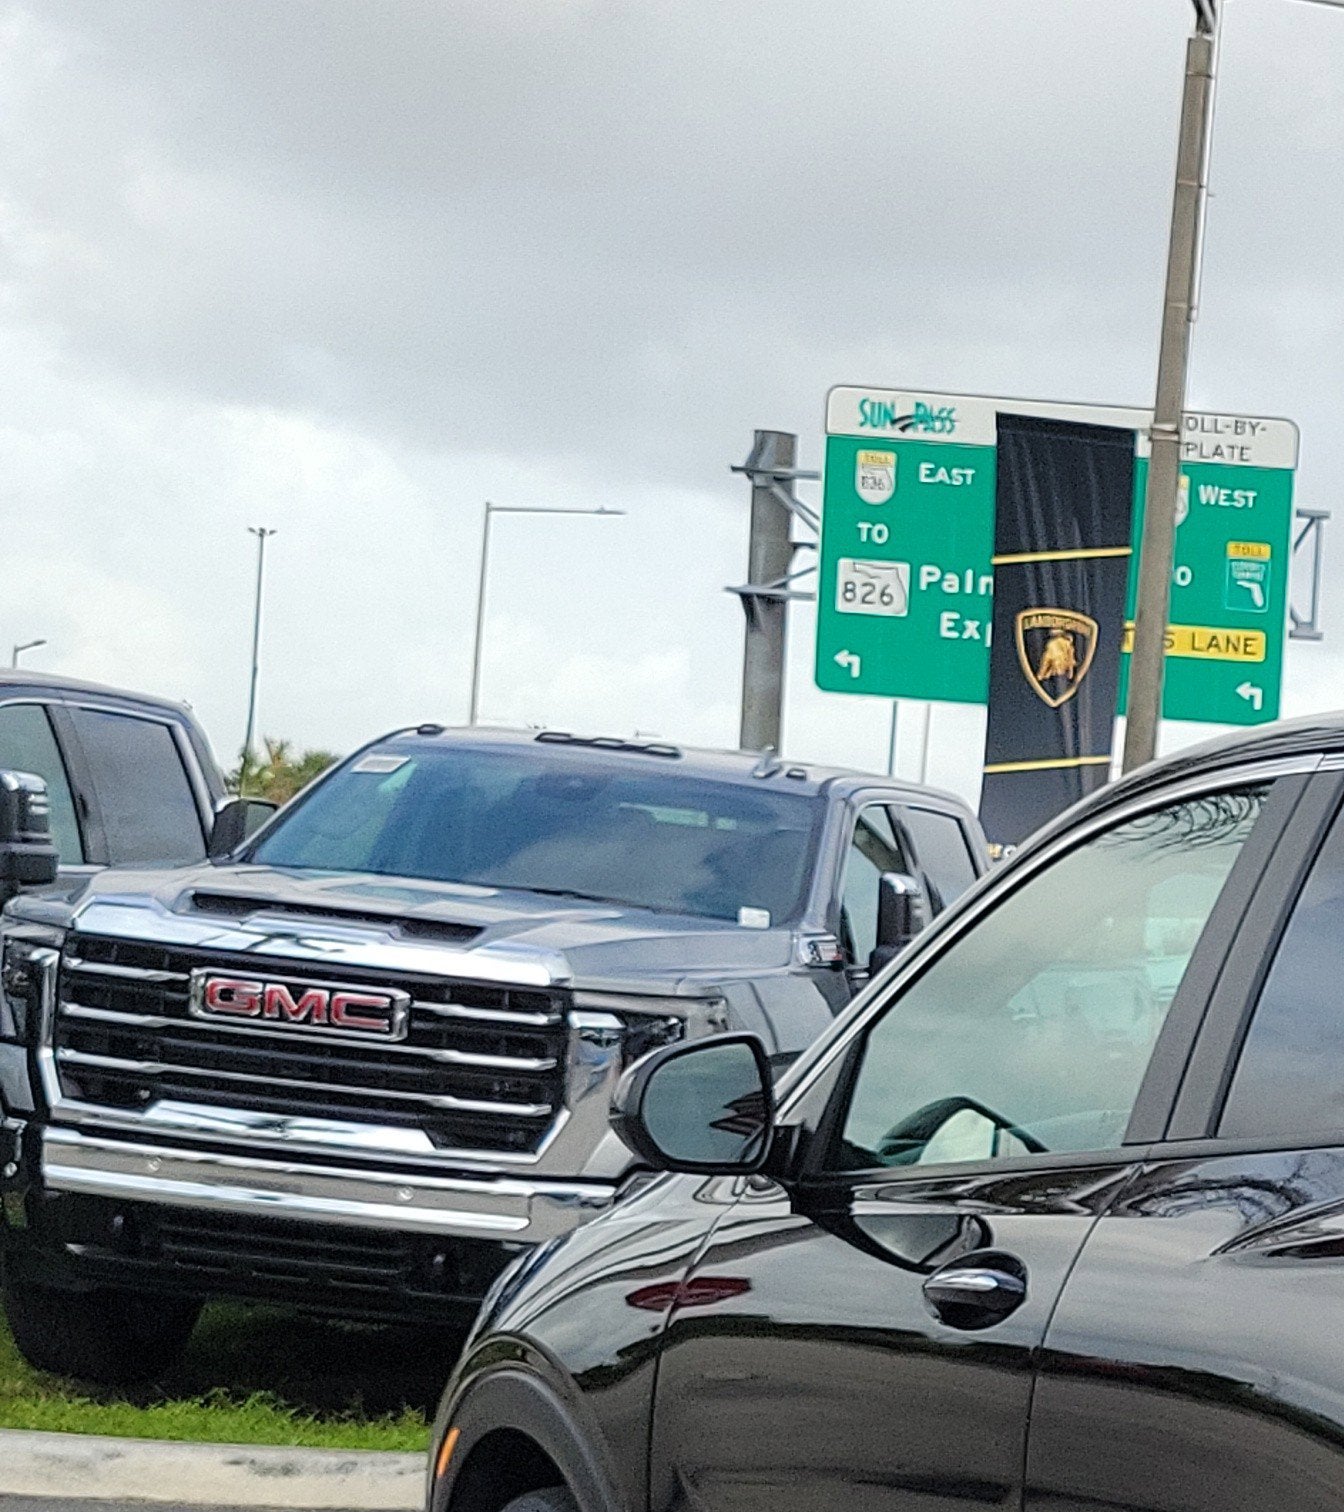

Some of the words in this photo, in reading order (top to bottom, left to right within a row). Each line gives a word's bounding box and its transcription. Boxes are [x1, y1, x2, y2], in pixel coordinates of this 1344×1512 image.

[1185, 416, 1267, 437] OLL-BY-
[919, 462, 976, 486] EAST
[1198, 484, 1258, 509] WEST
[857, 521, 889, 544] TO
[1174, 565, 1192, 587] O
[843, 580, 894, 606] 826
[1191, 632, 1258, 656] LANE
[204, 977, 391, 1032] GMC
